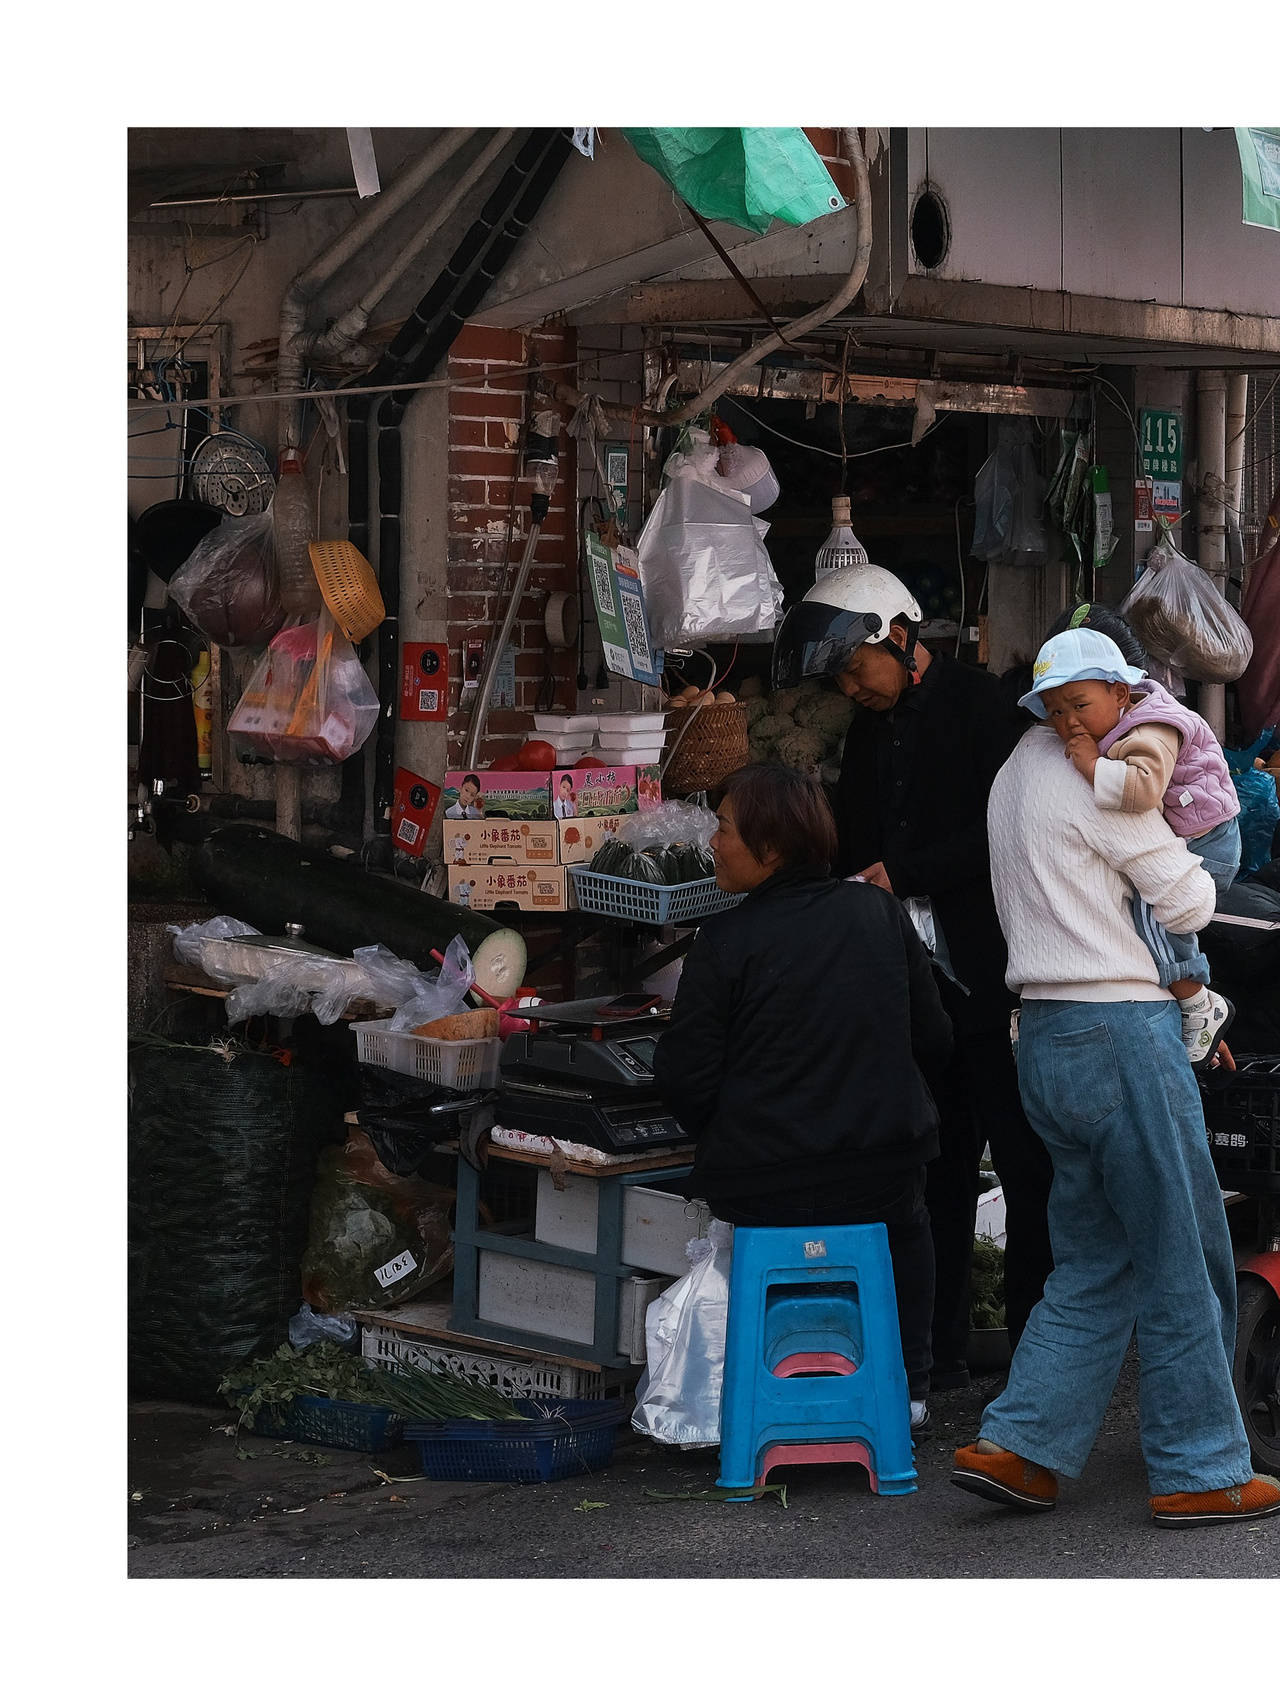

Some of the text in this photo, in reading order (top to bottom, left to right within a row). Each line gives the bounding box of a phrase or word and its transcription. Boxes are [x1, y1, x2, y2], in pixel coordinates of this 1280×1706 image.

[1144, 417, 1177, 454] 115
[1143, 458, 1177, 473] 四牌楼路
[480, 828, 521, 843] 小象番茄
[486, 874, 528, 889] 小象番茄
